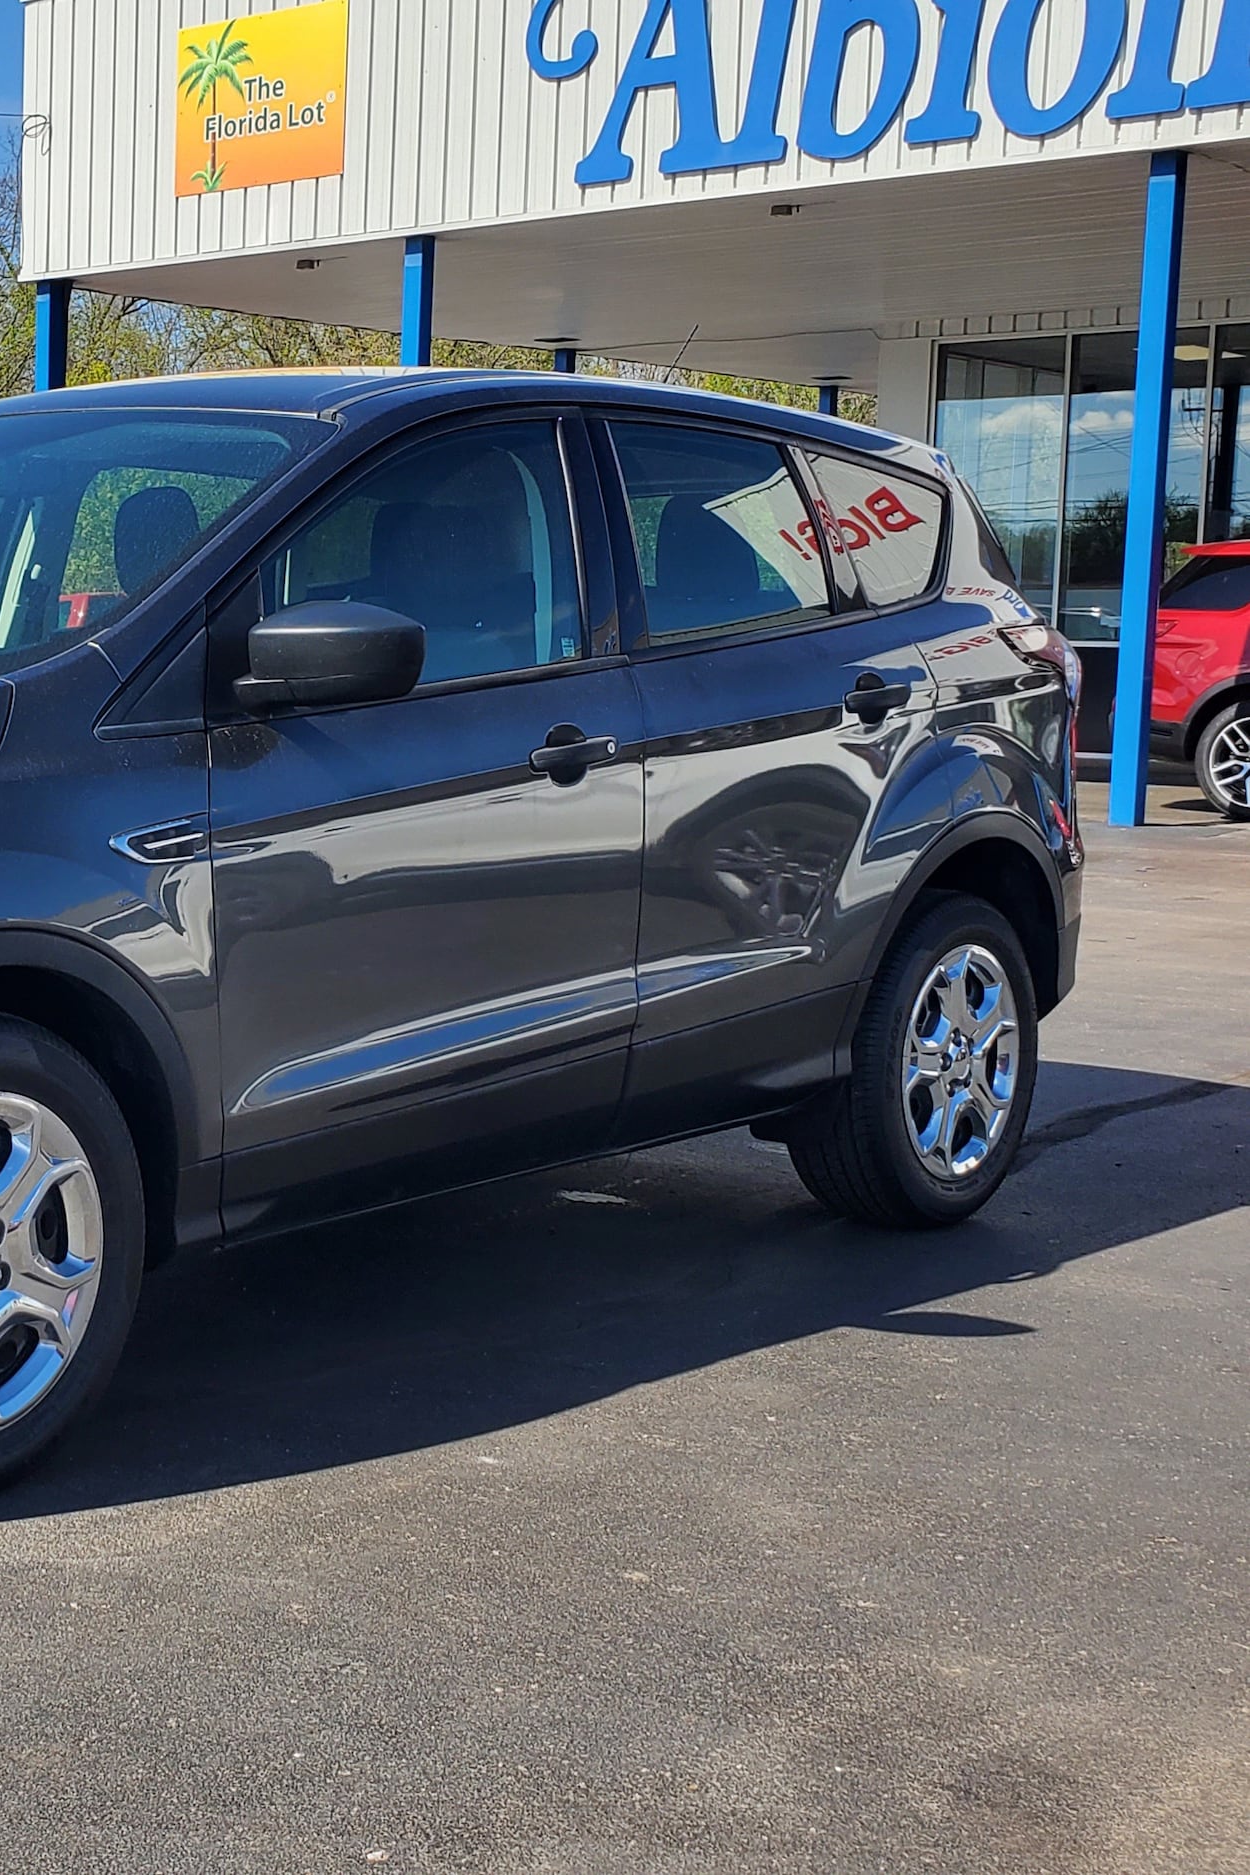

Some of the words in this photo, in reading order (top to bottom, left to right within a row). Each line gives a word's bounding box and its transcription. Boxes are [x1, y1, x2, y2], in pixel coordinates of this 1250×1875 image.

[244, 76, 284, 101] The
[205, 107, 281, 140] Florida
[288, 101, 325, 127] Lot
